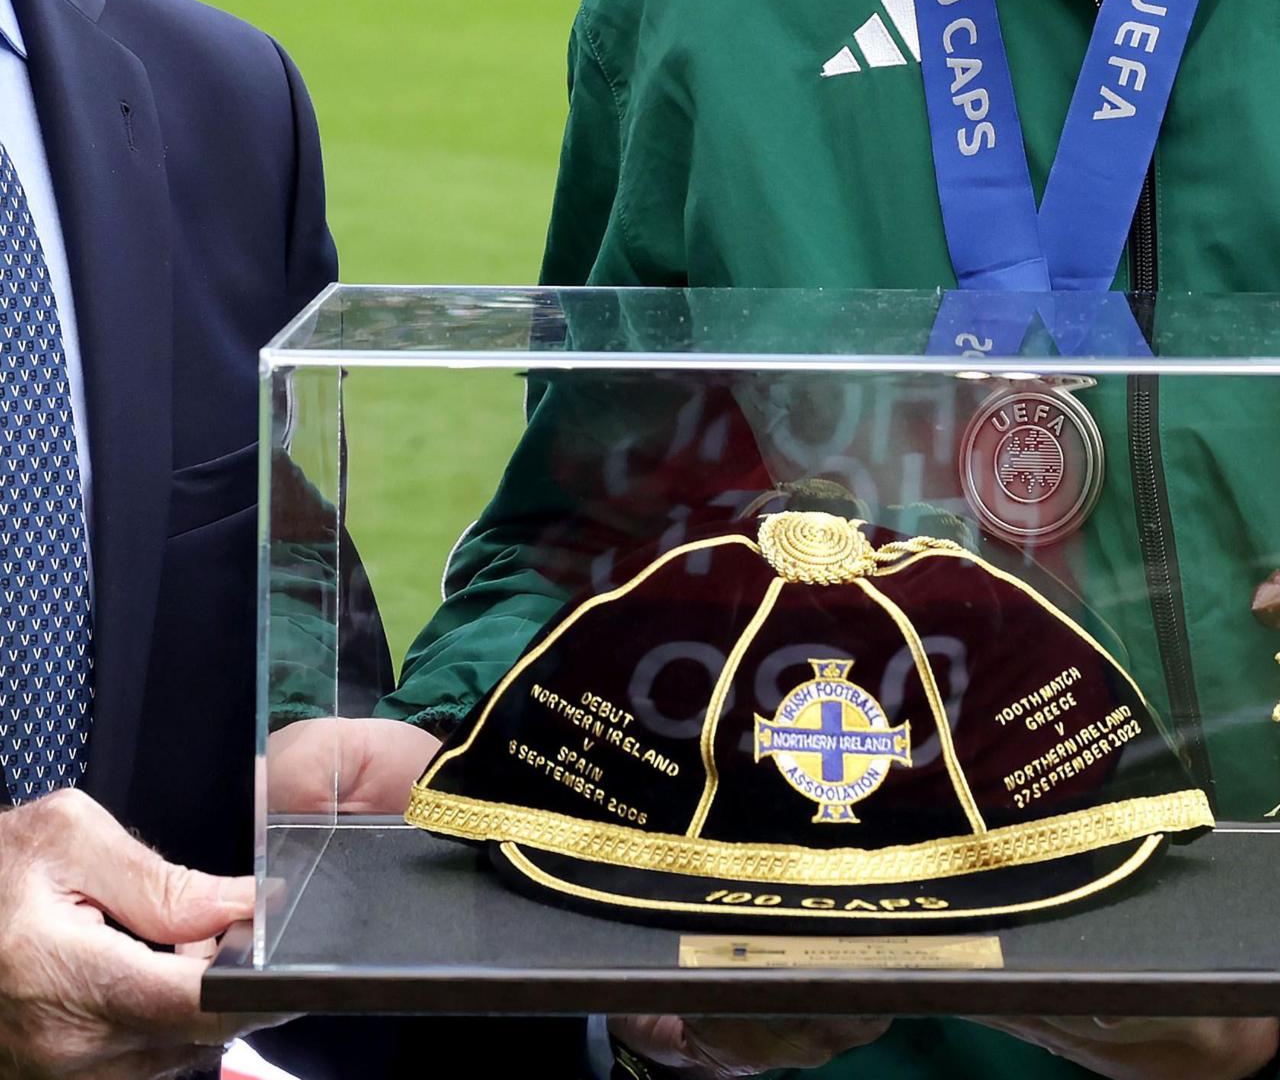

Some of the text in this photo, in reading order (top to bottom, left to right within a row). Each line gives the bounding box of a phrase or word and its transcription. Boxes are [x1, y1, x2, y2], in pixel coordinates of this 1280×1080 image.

[942, 17, 996, 156] CAPS
[991, 403, 1065, 436] UEFA
[581, 691, 634, 728] DEBUT
[781, 683, 880, 726] IRISH FOOTBALL
[995, 666, 1081, 726] 100TH MATCH
[1025, 692, 1077, 731] GREECE
[530, 683, 680, 777] NORTHERN IRELAND
[582, 737, 594, 751] V
[773, 731, 891, 752] NORTHERN IRELAND
[1004, 705, 1131, 791] NORTHERN IRELAND
[1054, 721, 1065, 736] V
[508, 739, 648, 825] 6 SEPTEMBER 2006
[557, 746, 603, 782] SPAIN
[1013, 719, 1142, 809] 27 SEPTEMBER 2022
[704, 890, 949, 911] 100 CAPS
